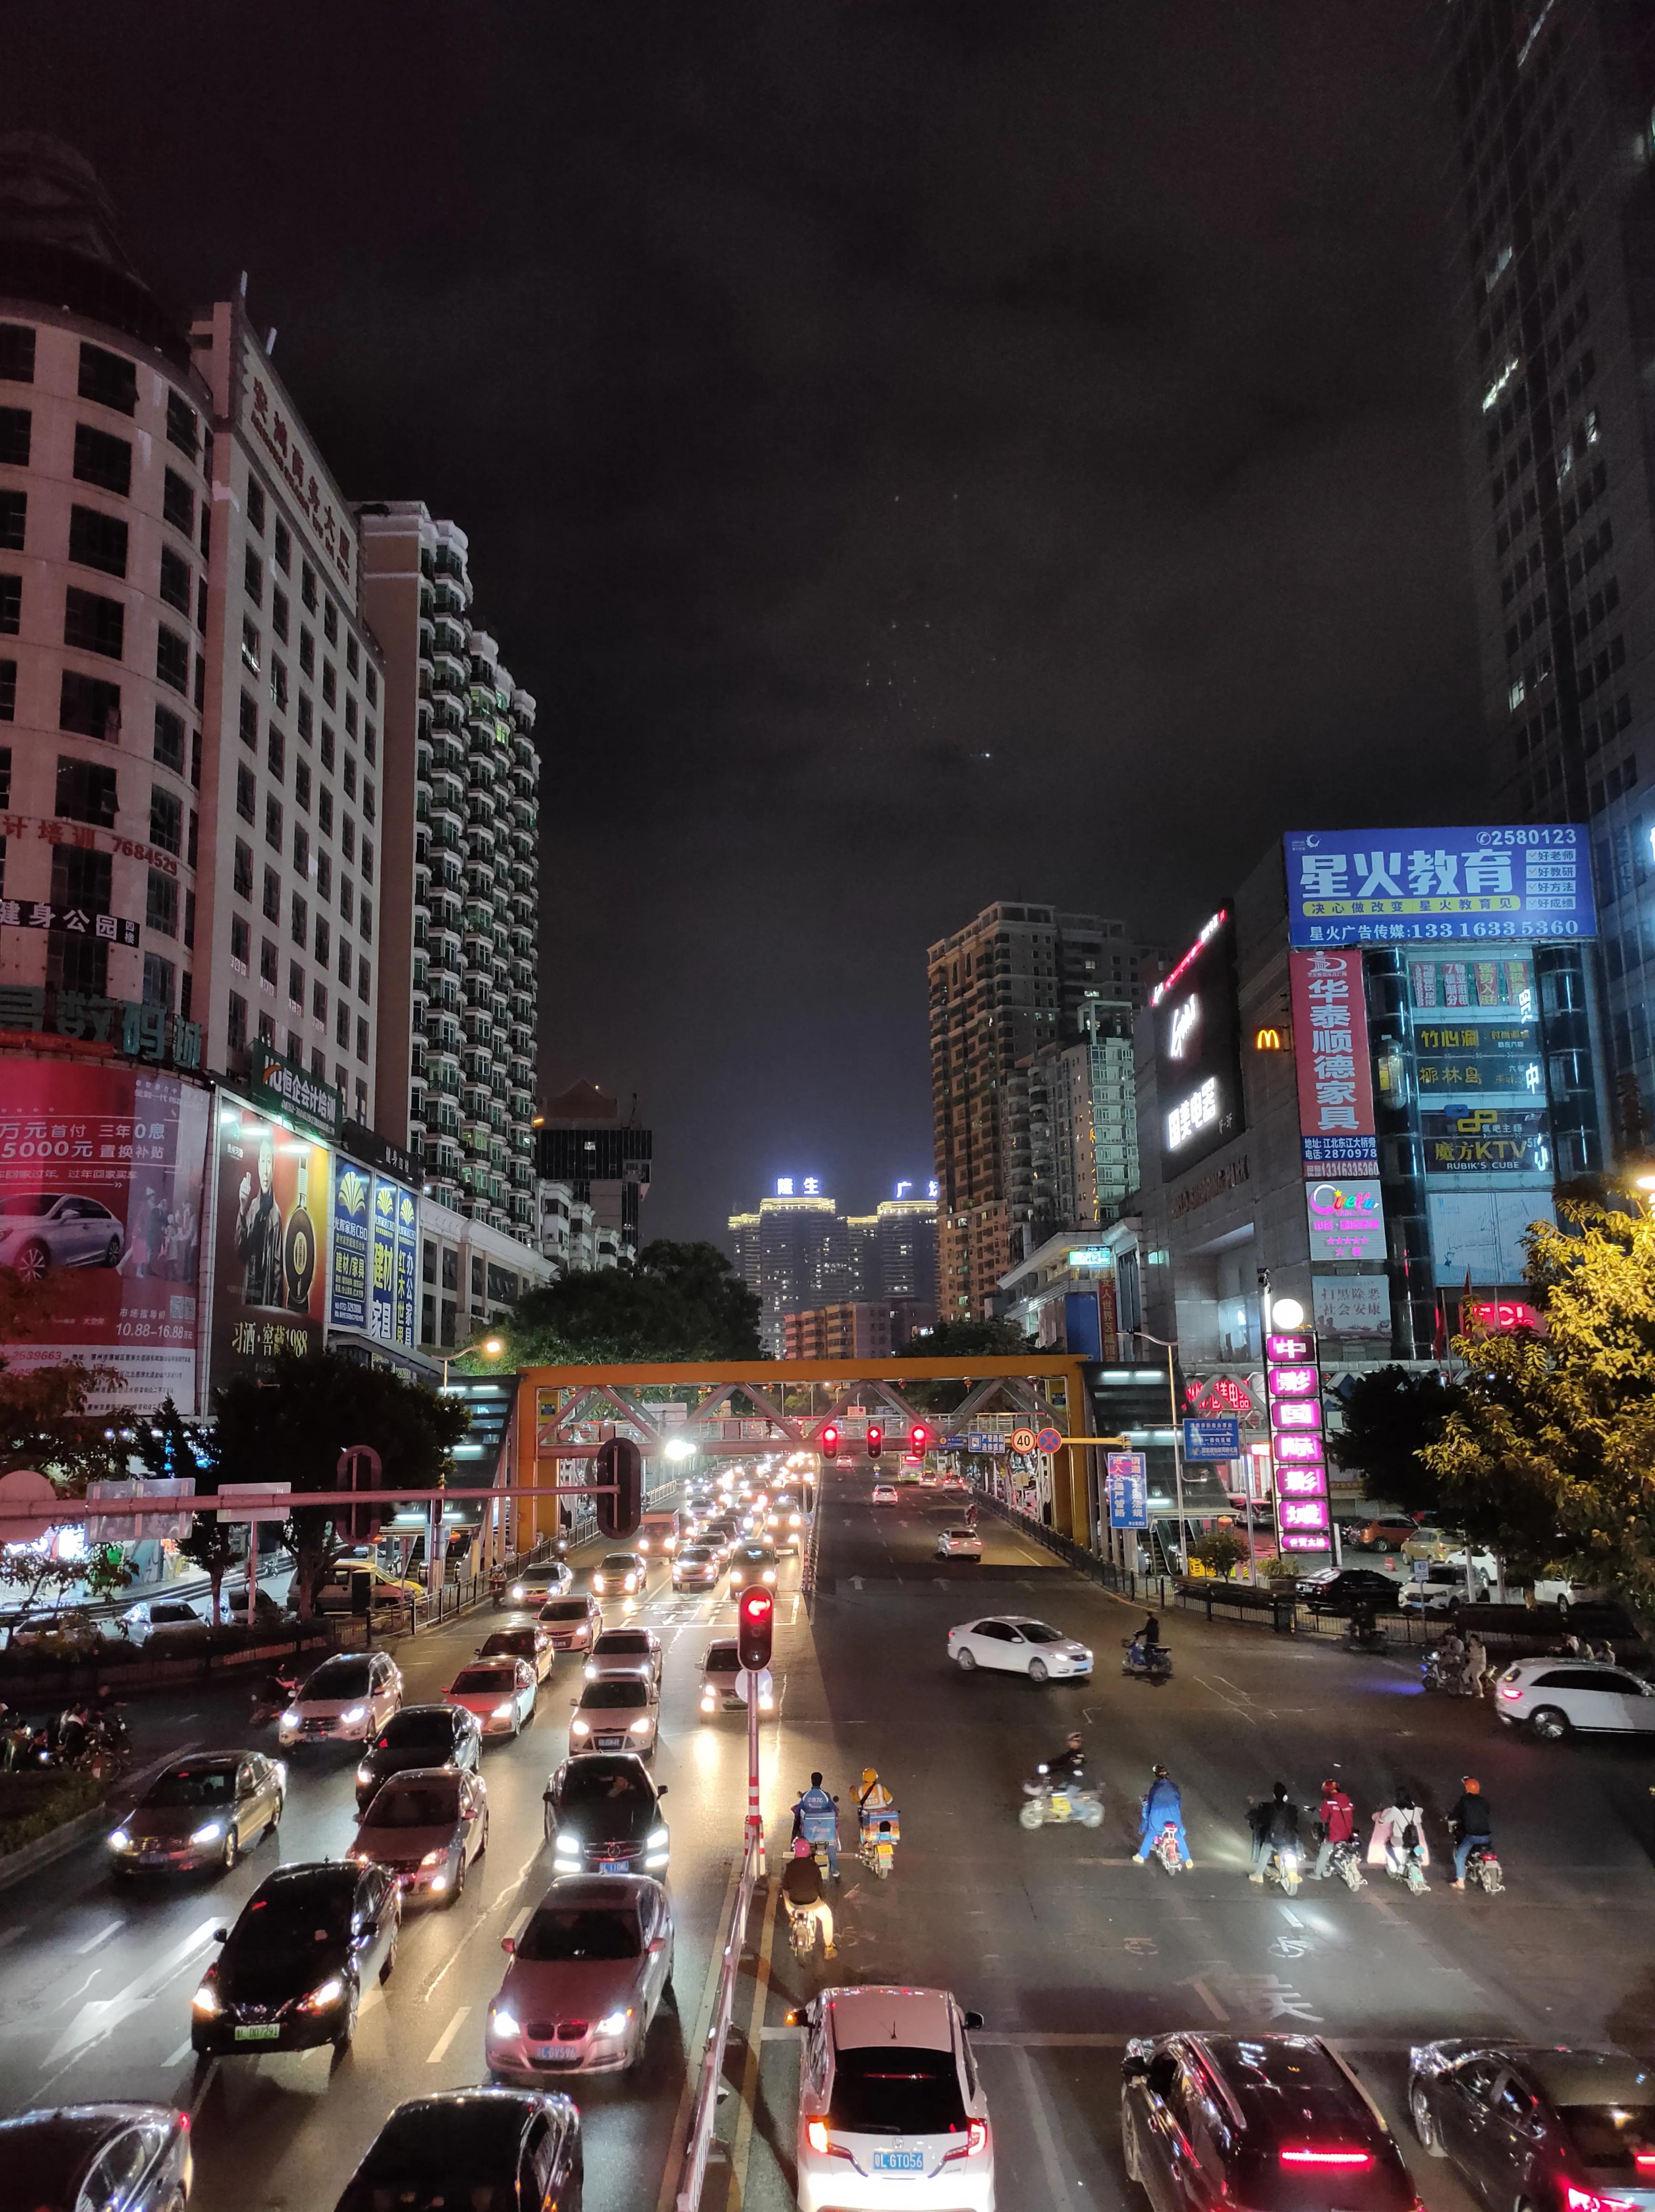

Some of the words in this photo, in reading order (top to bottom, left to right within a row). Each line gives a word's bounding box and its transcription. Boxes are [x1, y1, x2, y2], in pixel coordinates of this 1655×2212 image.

[1491, 829, 1576, 845] 2580123
[112, 837, 178, 876] 7684529
[1538, 851, 1573, 861] 好老师
[1300, 849, 1513, 898] 星火教育
[1538, 867, 1573, 877] 好教研
[1538, 882, 1573, 892] 好方法
[1312, 901, 1404, 914] 决心做改变
[1419, 898, 1512, 911] 星火教育见
[1538, 898, 1573, 909] 好成绩
[1308, 979, 1360, 1131] 华泰顺德家具
[1168, 1077, 1216, 1149] 国美电器
[98, 1122, 165, 1140] 三年0息
[99, 1144, 164, 1159] 置换补贴
[1325, 1148, 1377, 1158] 2870978
[1447, 1162, 1487, 1170] RUBIK'S
[374, 1242, 393, 1292] 建材
[1321, 1287, 1381, 1301] 扫黑除恶
[1324, 1302, 1381, 1316] 社会安康
[1017, 1435, 1031, 1446] 40
